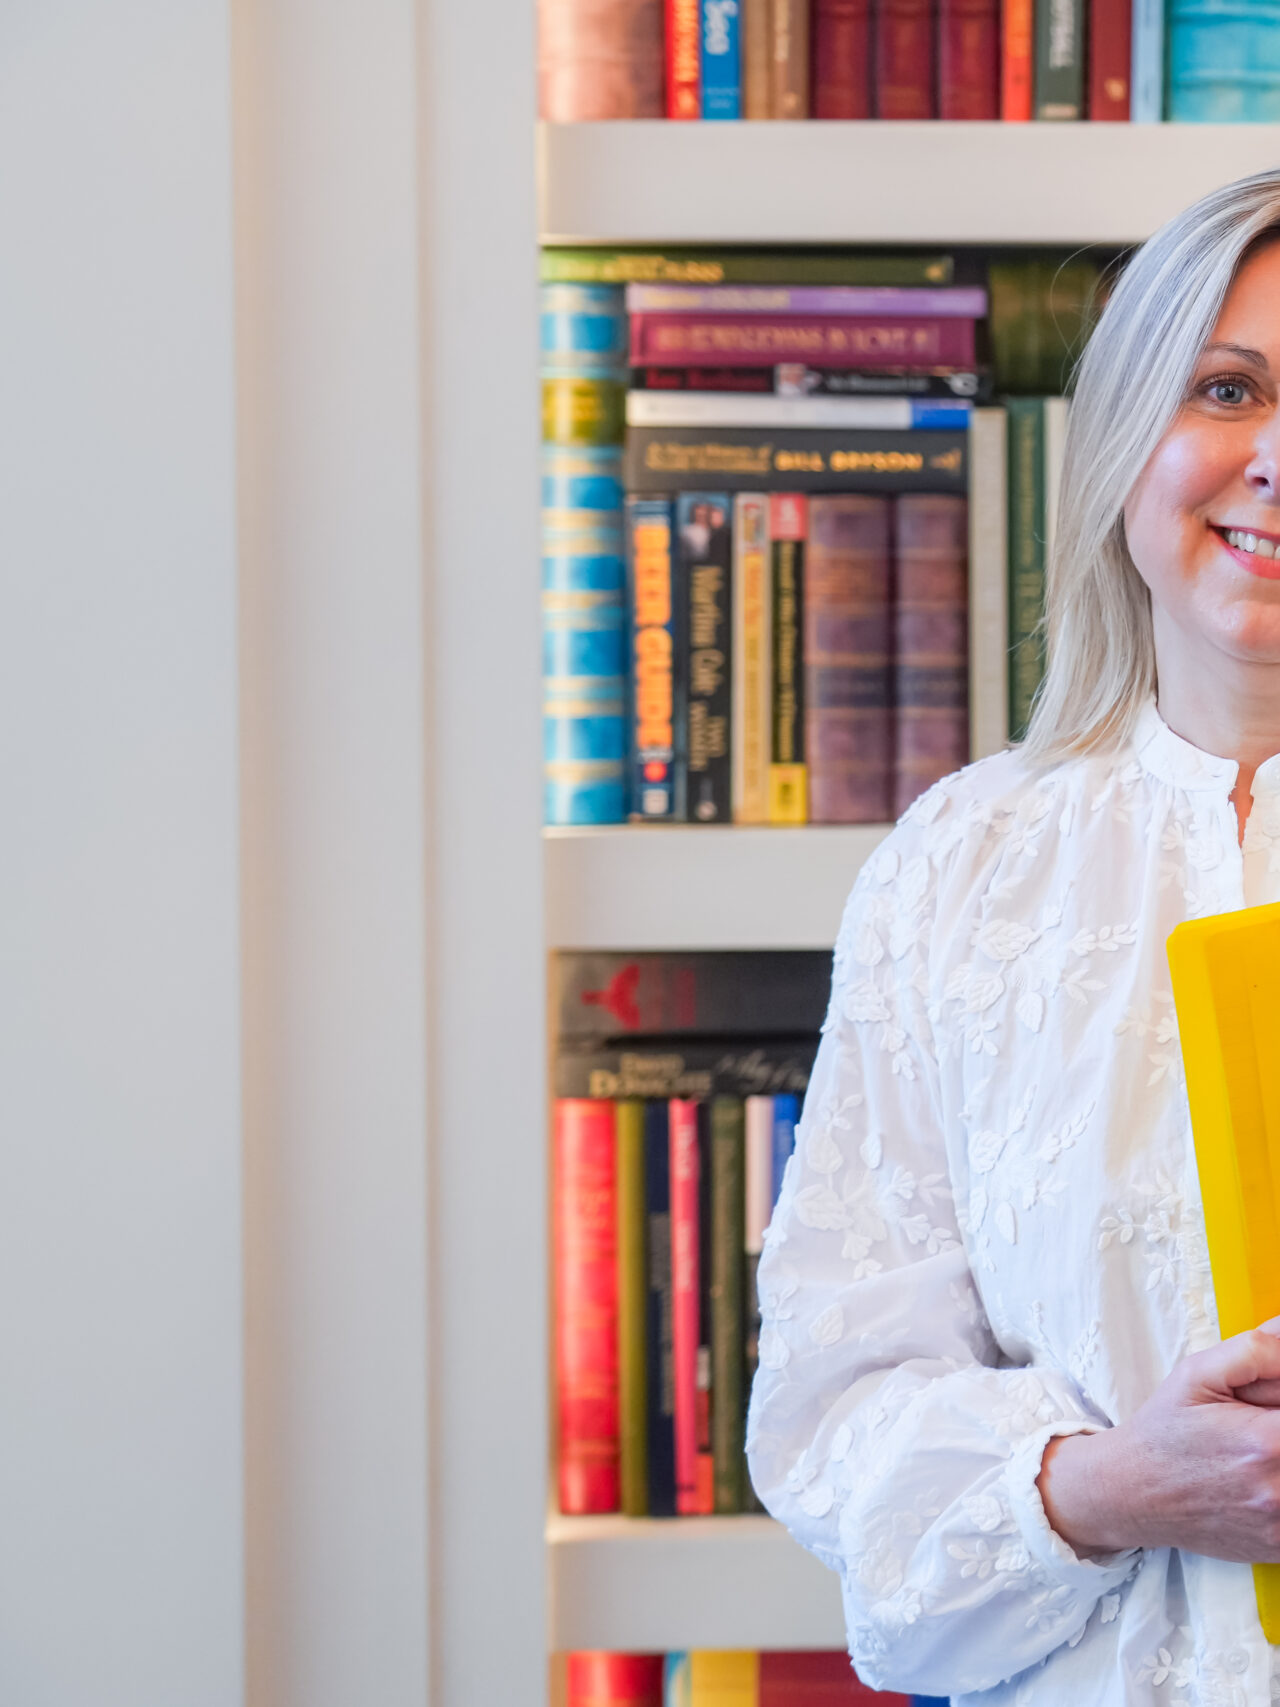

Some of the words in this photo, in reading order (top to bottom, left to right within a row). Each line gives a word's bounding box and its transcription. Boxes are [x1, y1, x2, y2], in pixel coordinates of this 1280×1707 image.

[774, 450, 825, 472] BILL
[830, 450, 924, 473] BRYSON
[635, 524, 672, 627] BEER
[690, 565, 723, 648] Martina
[635, 627, 673, 748] GUIDE
[691, 648, 726, 696] Cole
